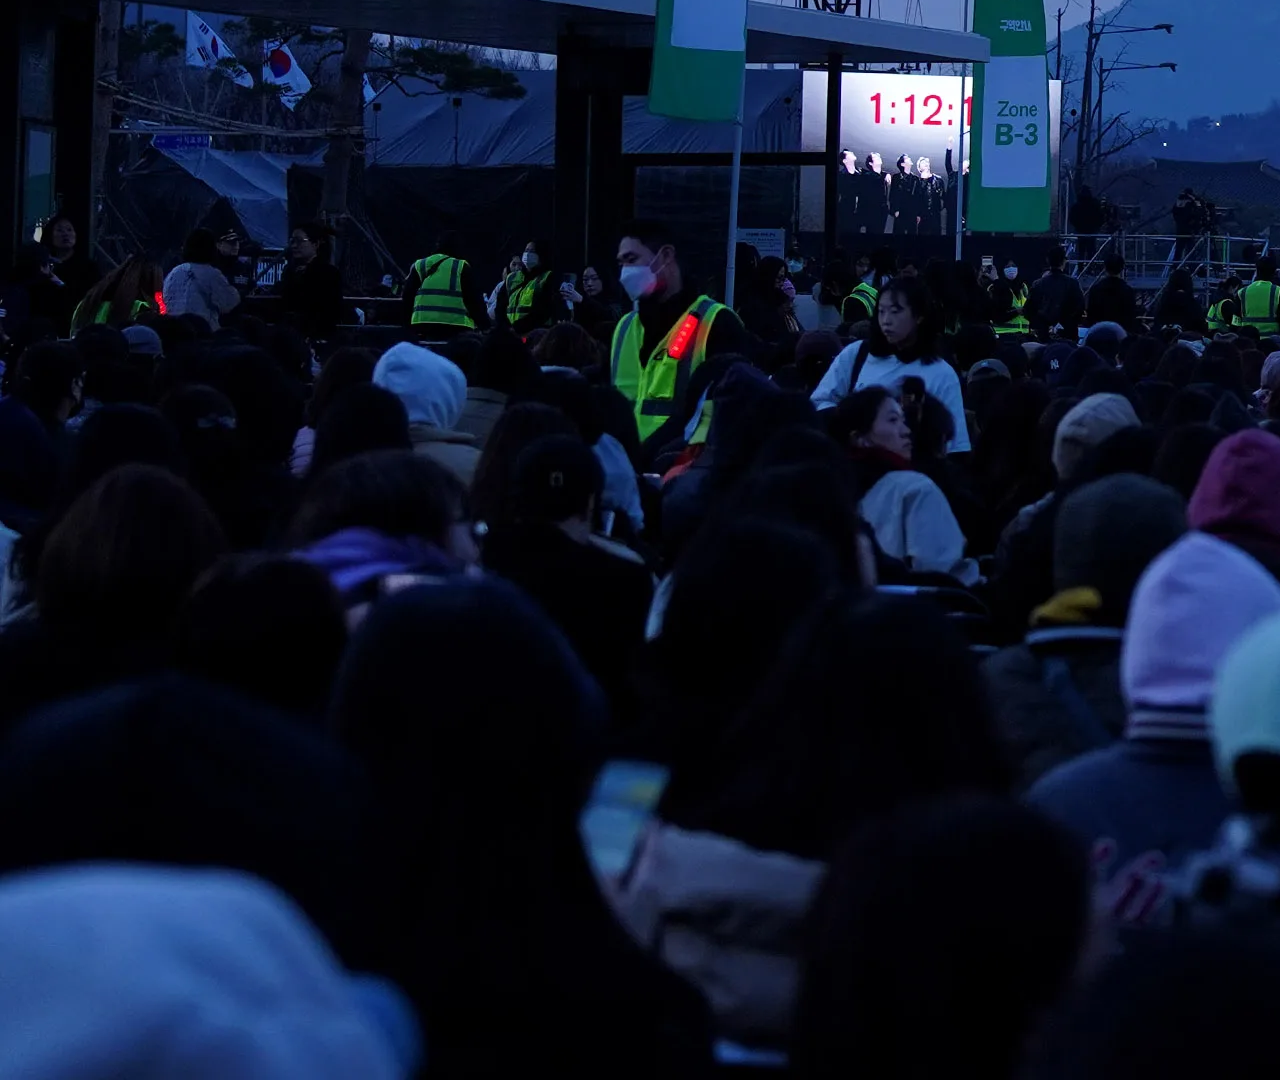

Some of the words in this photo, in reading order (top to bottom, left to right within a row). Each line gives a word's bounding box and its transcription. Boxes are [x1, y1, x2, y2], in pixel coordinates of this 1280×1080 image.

[870, 92, 972, 126] 1:12:1
[997, 100, 1038, 117] Zone
[995, 123, 1038, 146] B-3
